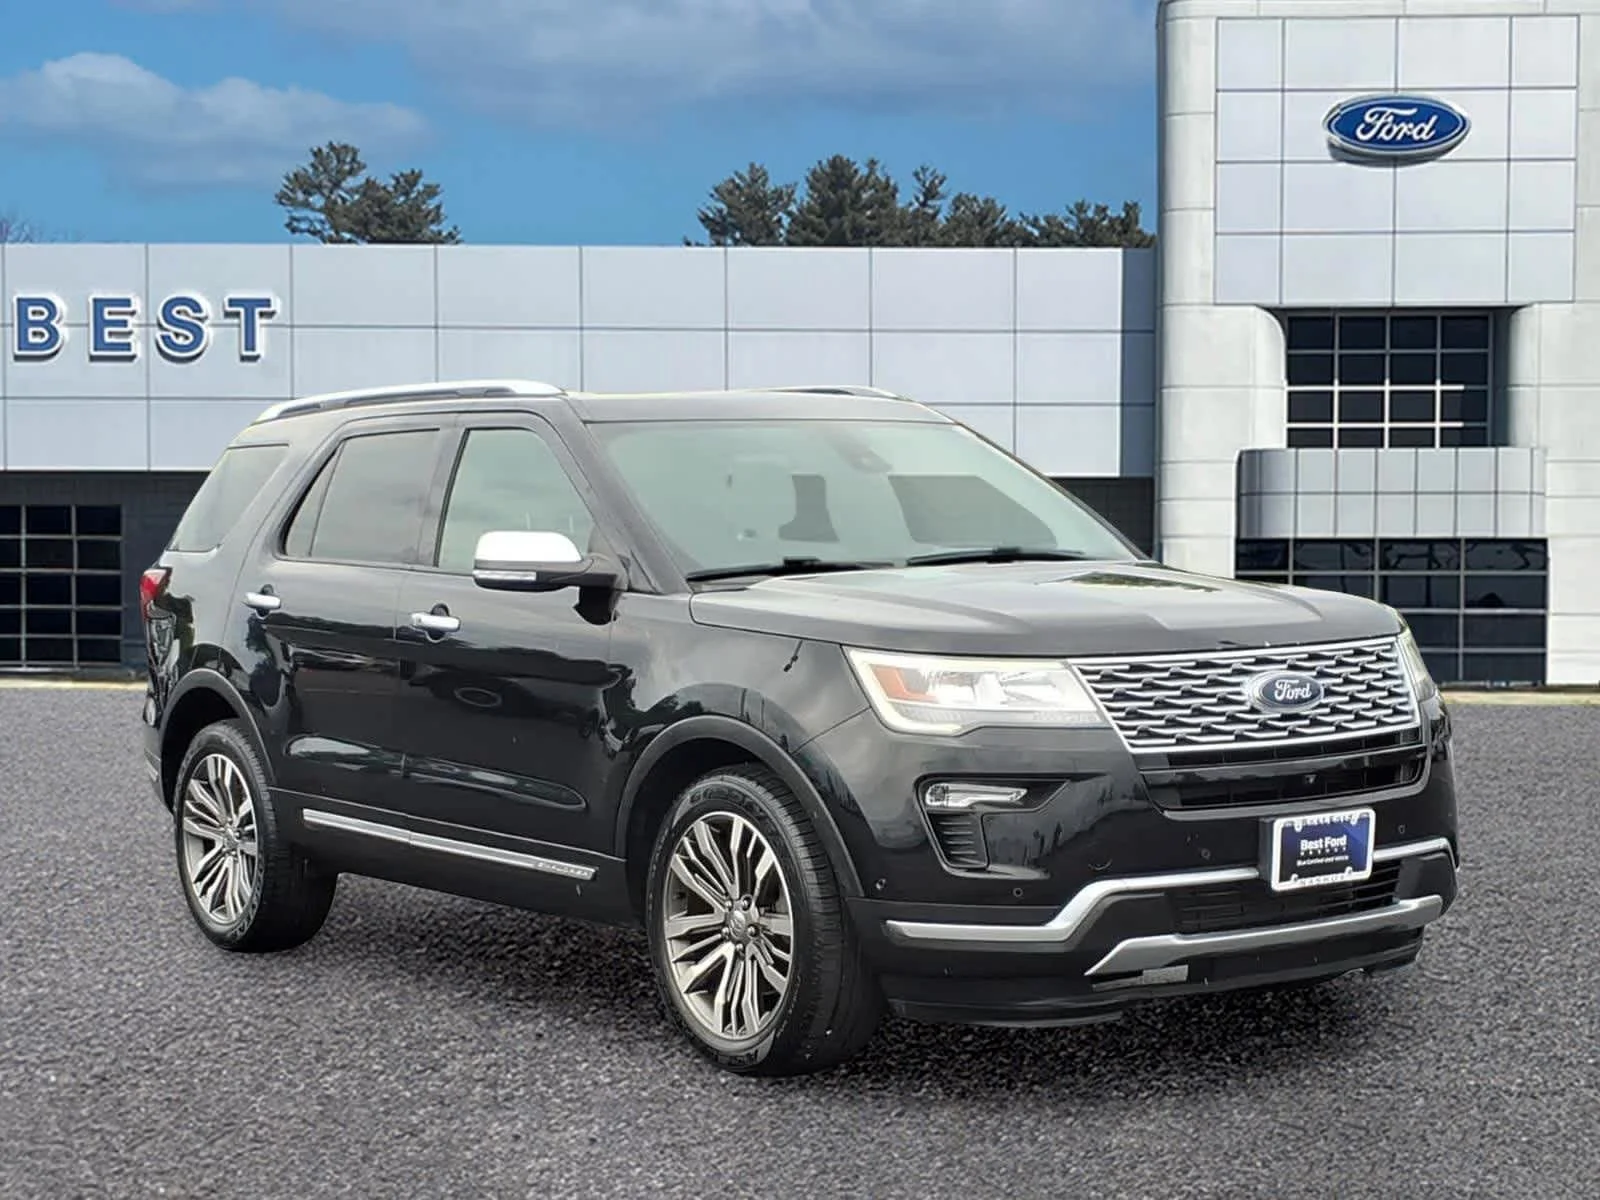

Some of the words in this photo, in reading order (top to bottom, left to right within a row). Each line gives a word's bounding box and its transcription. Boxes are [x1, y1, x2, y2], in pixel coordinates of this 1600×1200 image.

[1355, 107, 1439, 141] Ford
[14, 294, 277, 357] BEST
[1274, 679, 1312, 701] Ford
[1300, 838, 1323, 851] Best
[1324, 834, 1348, 849] Ford
